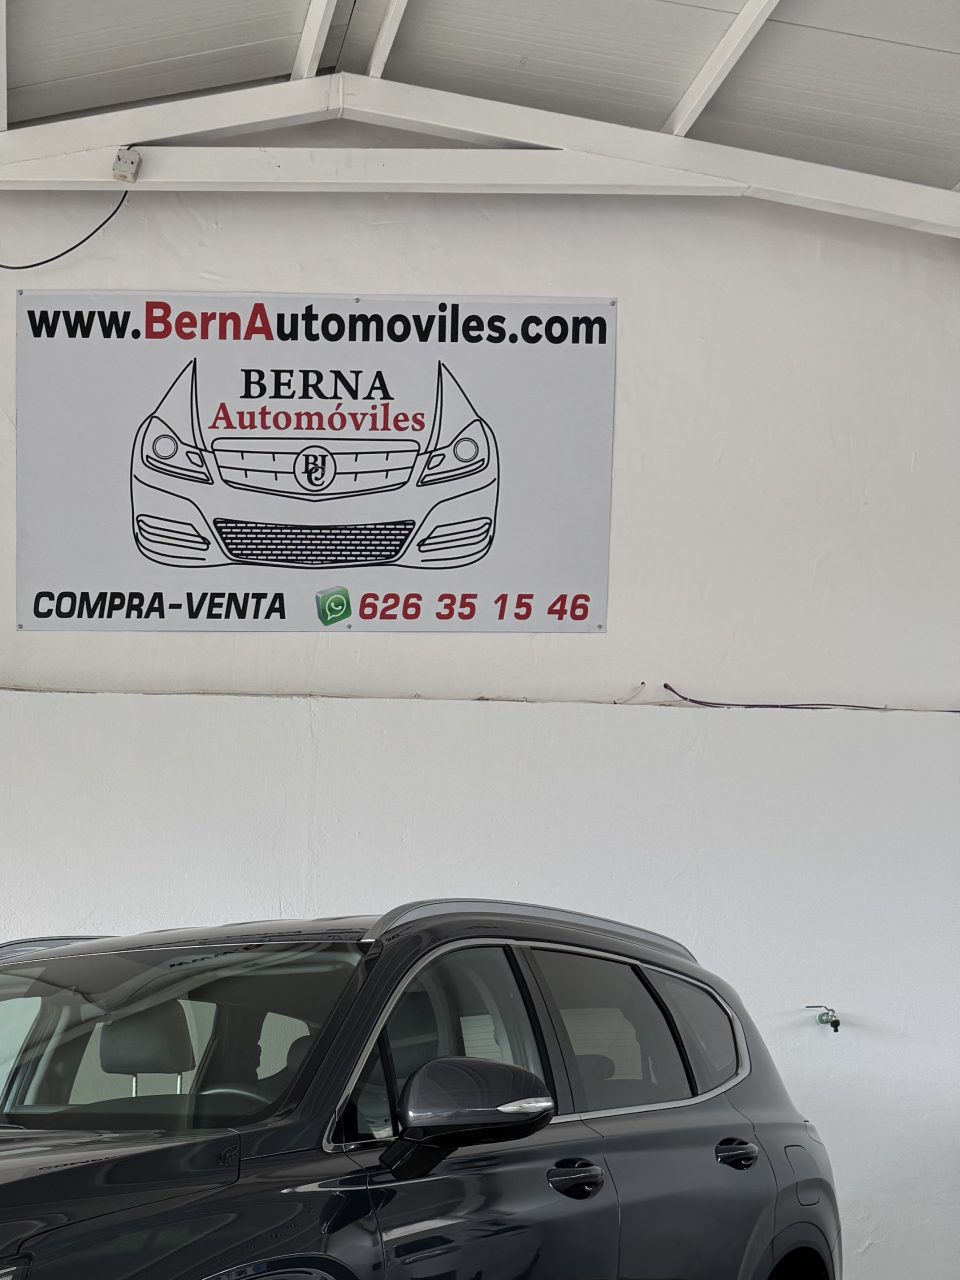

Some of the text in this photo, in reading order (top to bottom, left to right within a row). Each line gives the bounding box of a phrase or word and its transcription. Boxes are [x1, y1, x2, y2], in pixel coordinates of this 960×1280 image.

[27, 301, 608, 345] www.BernAutomoviles.com
[240, 368, 394, 402] BERNA
[207, 402, 426, 433] Automóviles
[32, 591, 287, 621] COMPRA-VENTA
[358, 593, 590, 621] 626 35 15 46
